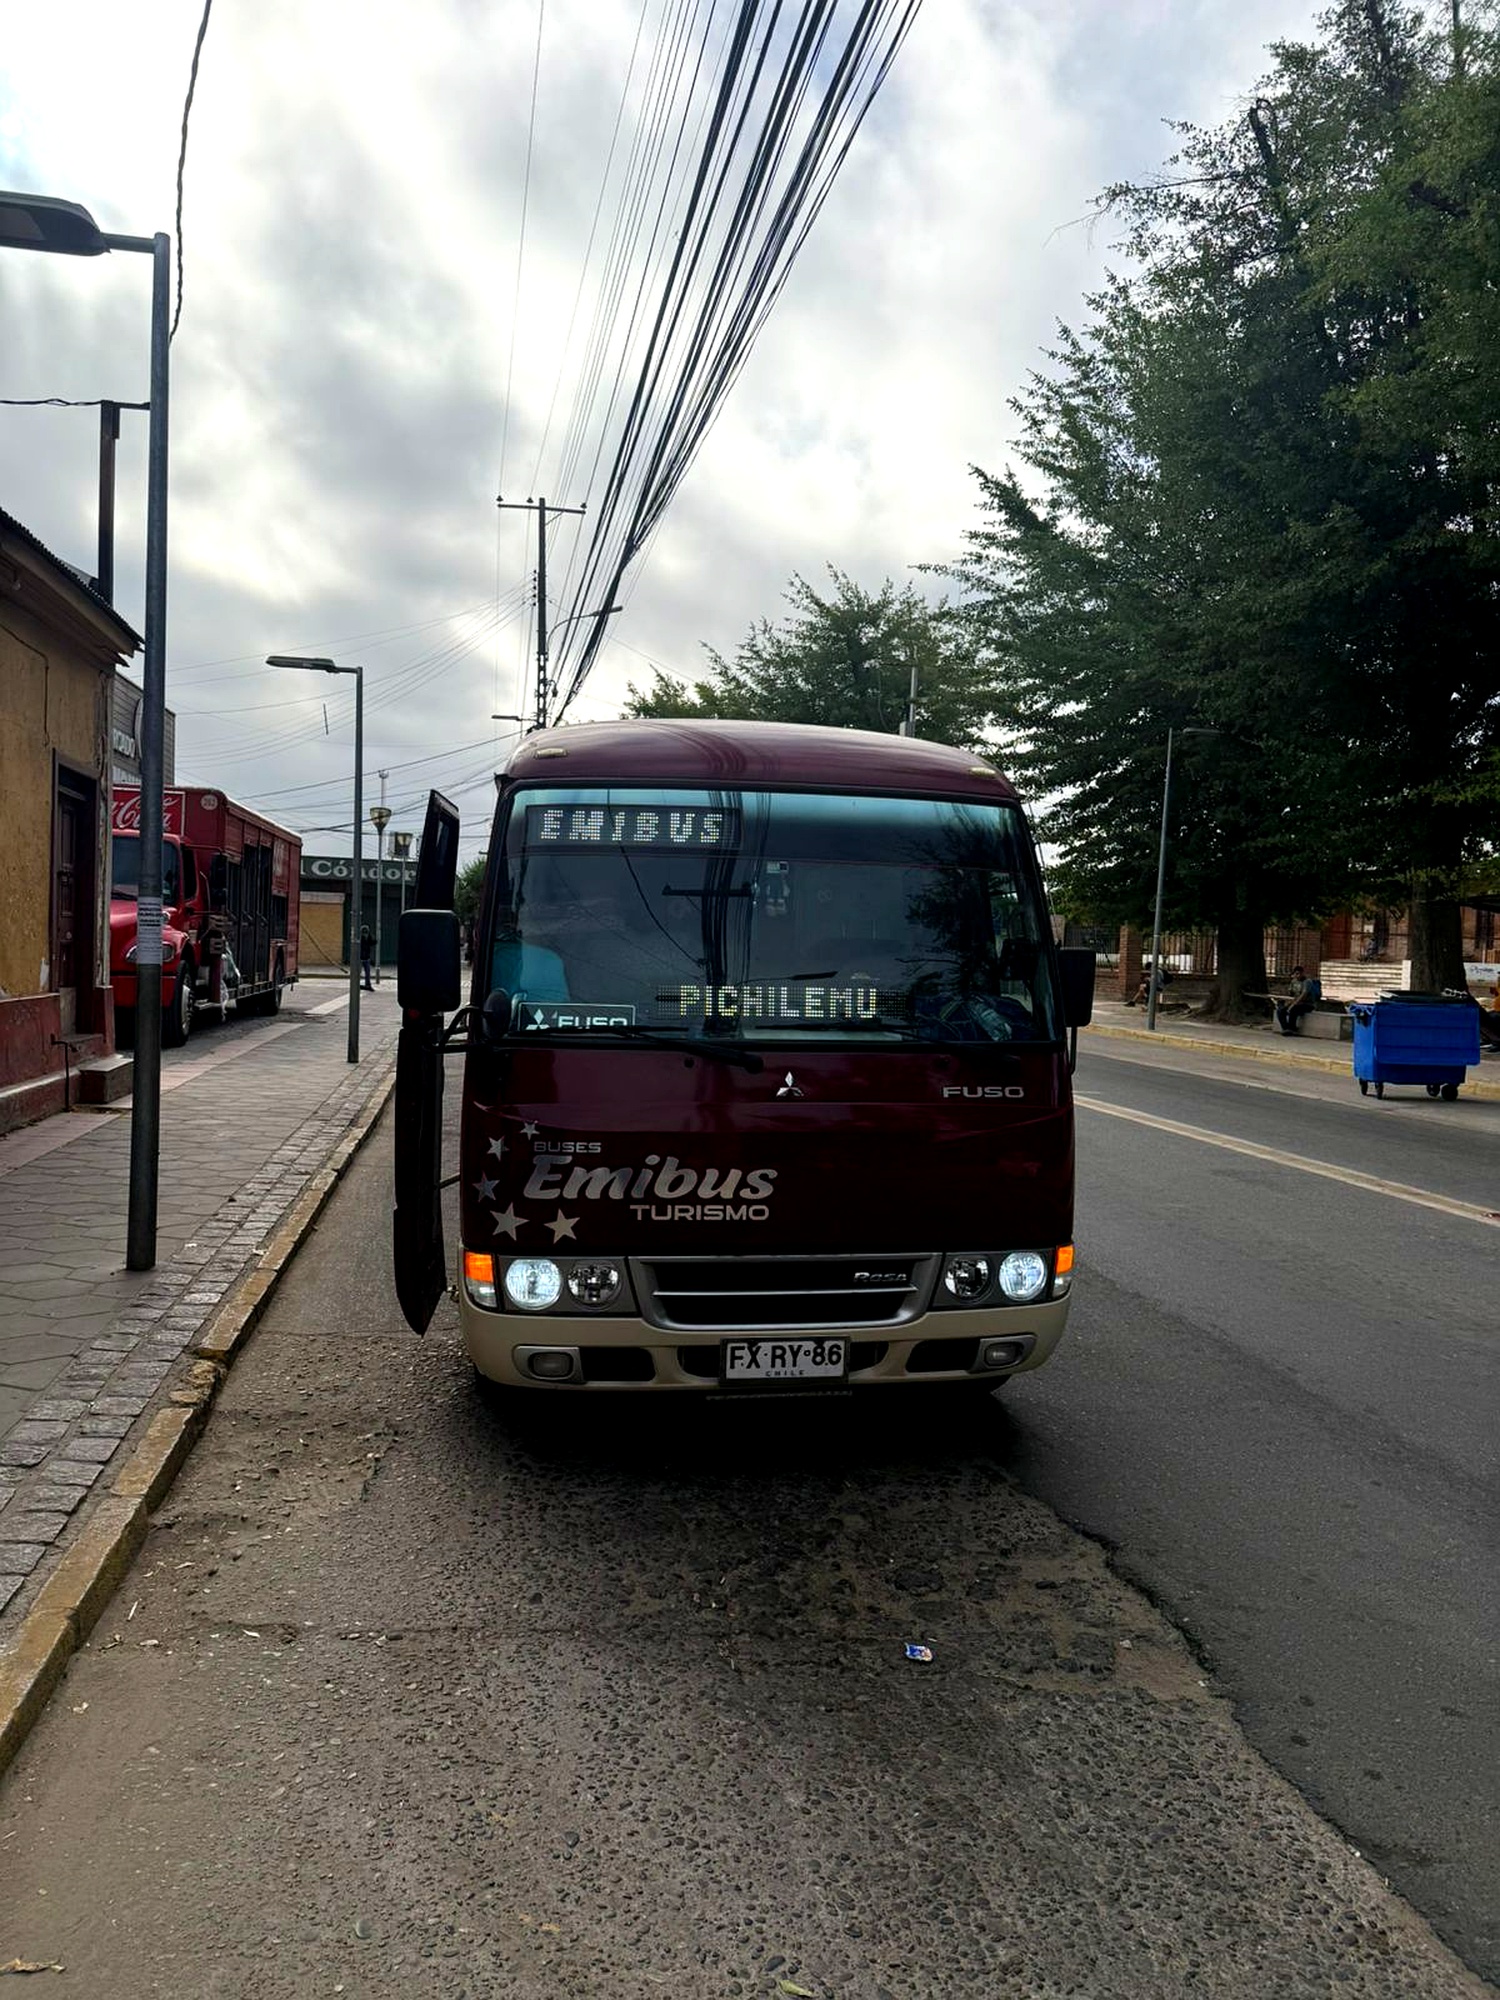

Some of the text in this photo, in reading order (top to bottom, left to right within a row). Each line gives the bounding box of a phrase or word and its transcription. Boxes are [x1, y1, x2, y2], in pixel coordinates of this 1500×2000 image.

[540, 810, 723, 843] EMIBUS
[680, 986, 877, 1019] PICHILEMU
[943, 1086, 1025, 1098] FUSO
[534, 1141, 601, 1153] BUSES
[523, 1154, 778, 1199] Emibus
[630, 1204, 769, 1220] TURISMO
[765, 1369, 805, 1377] CHILE
